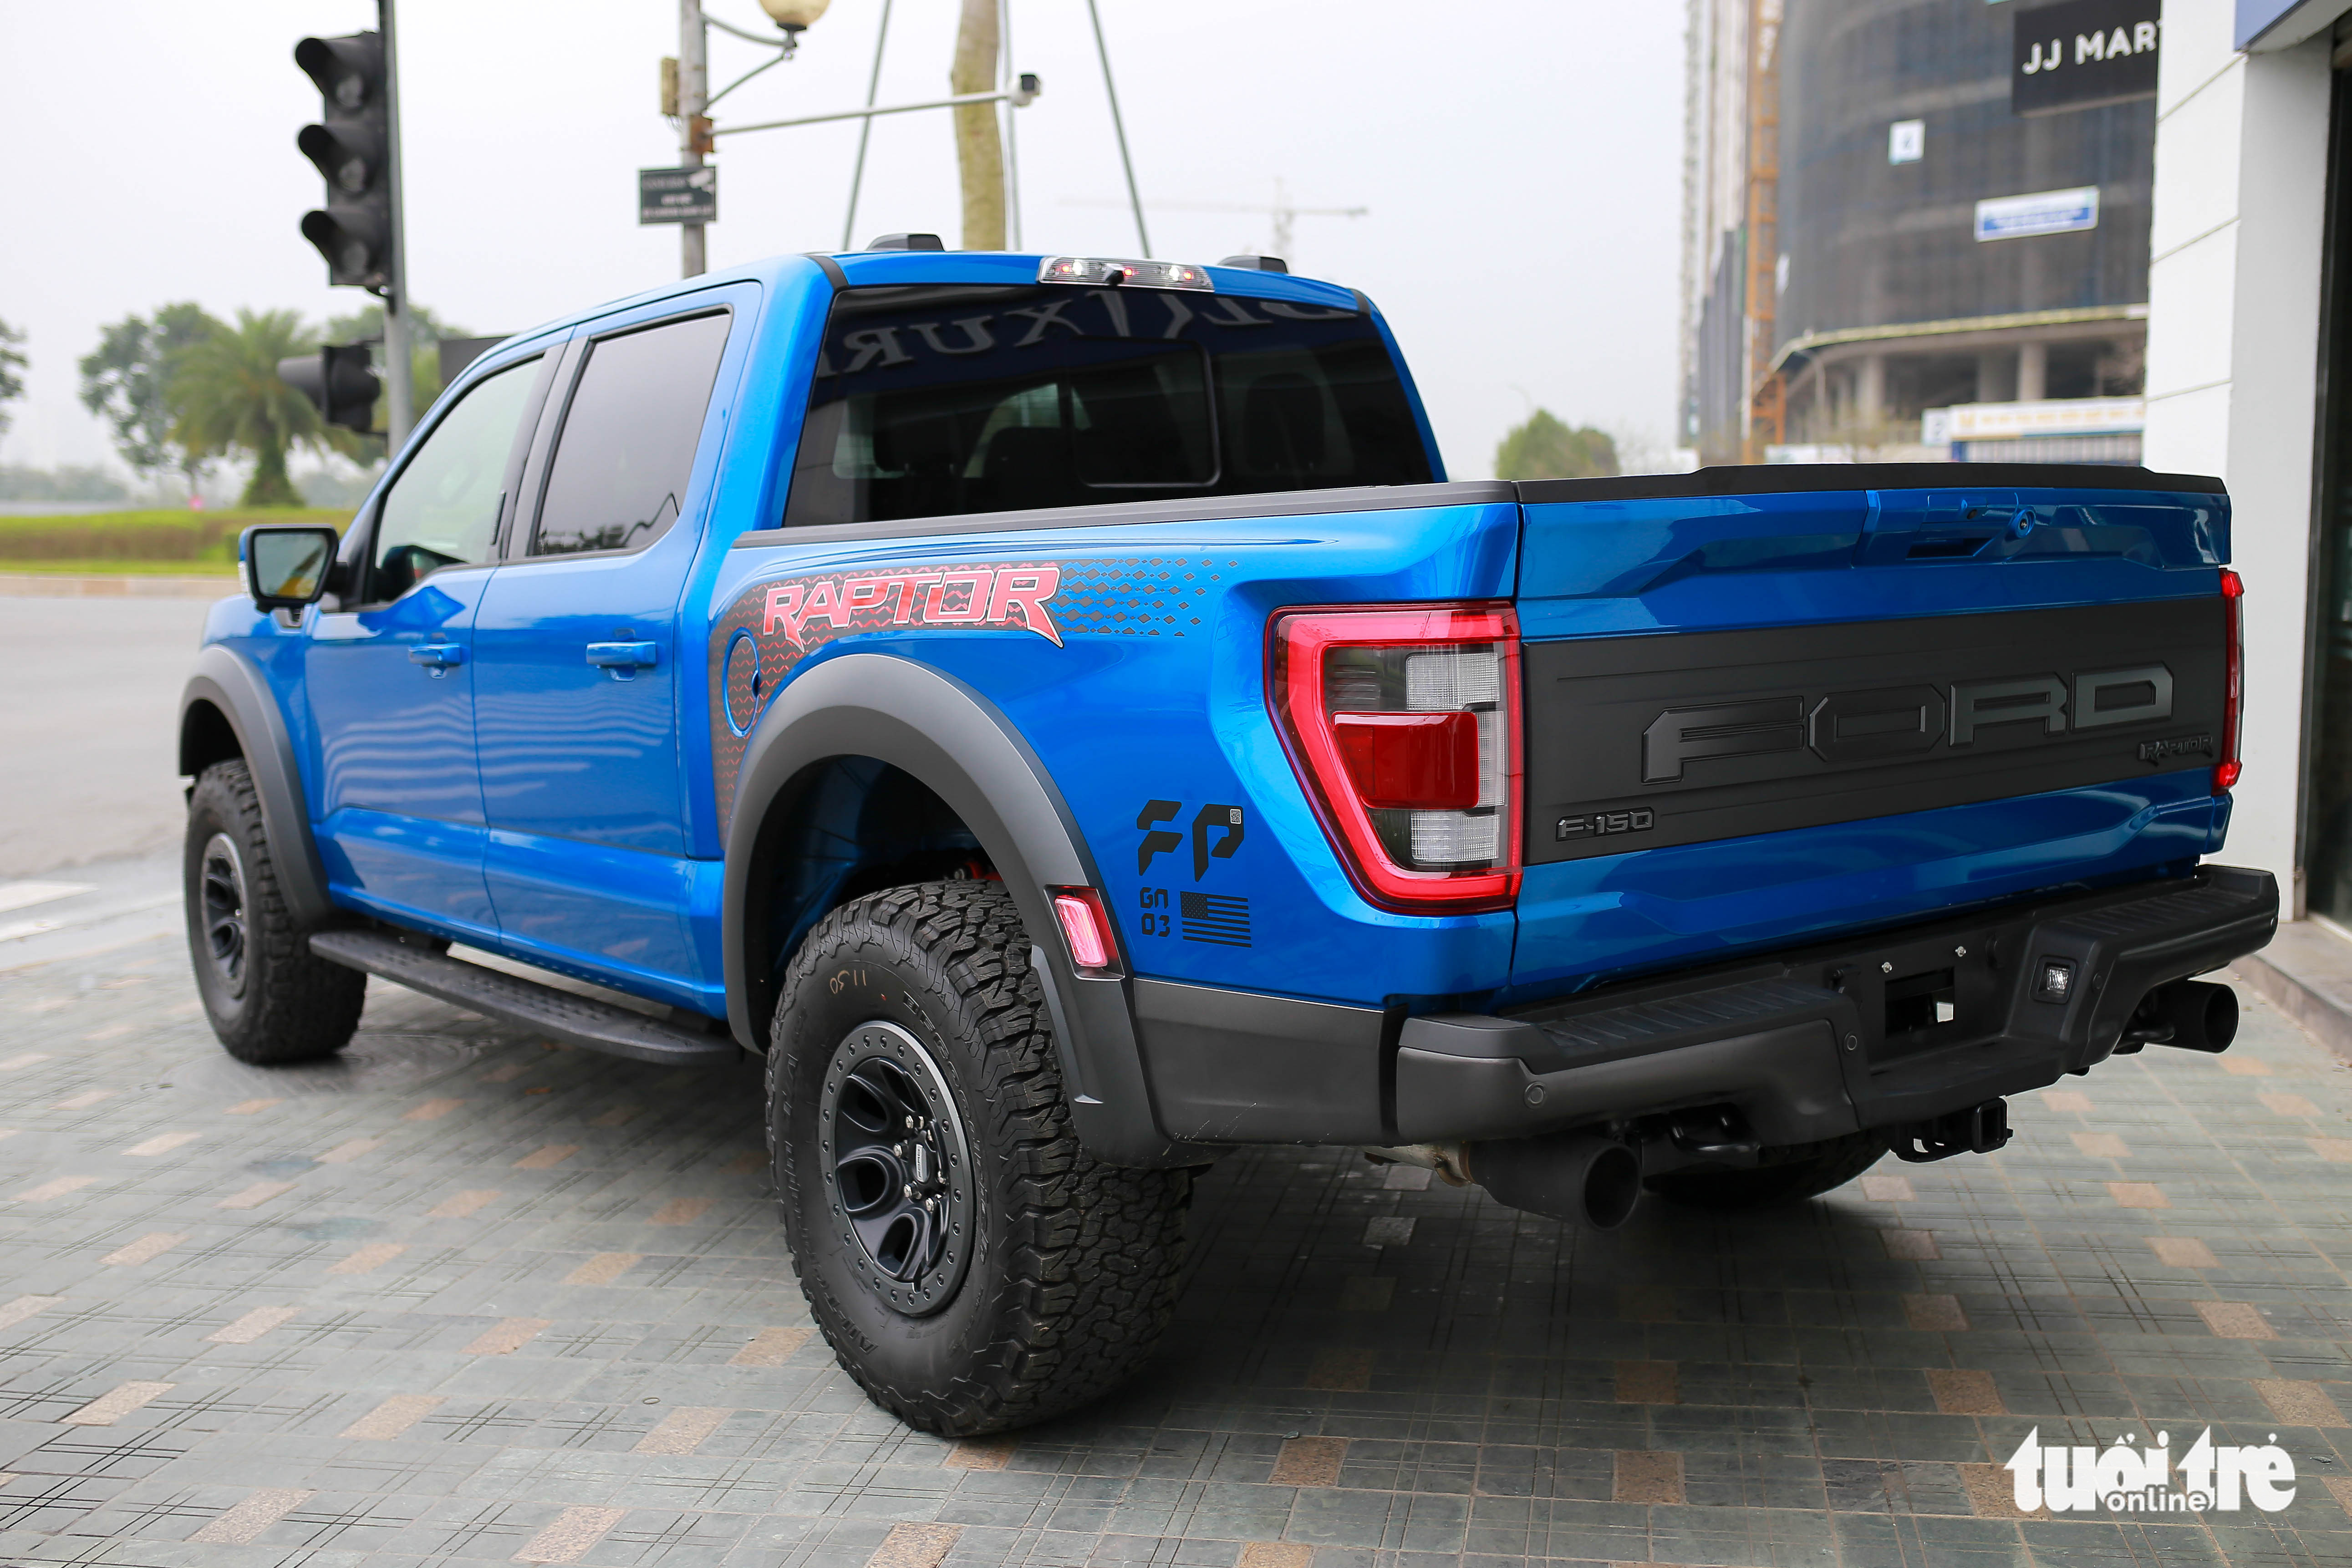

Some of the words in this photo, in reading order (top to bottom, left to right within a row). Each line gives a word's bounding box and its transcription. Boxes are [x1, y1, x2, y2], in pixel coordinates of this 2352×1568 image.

[2022, 38, 2062, 75] JJ
[2075, 20, 2161, 65] MAR
[763, 567, 1064, 653] RAPTOR
[1641, 662, 2173, 784] FORD
[2138, 736, 2214, 767] RAPTOR
[1136, 799, 1244, 882] FP
[1557, 810, 1653, 838] F-150
[1141, 913, 1170, 937] 03
